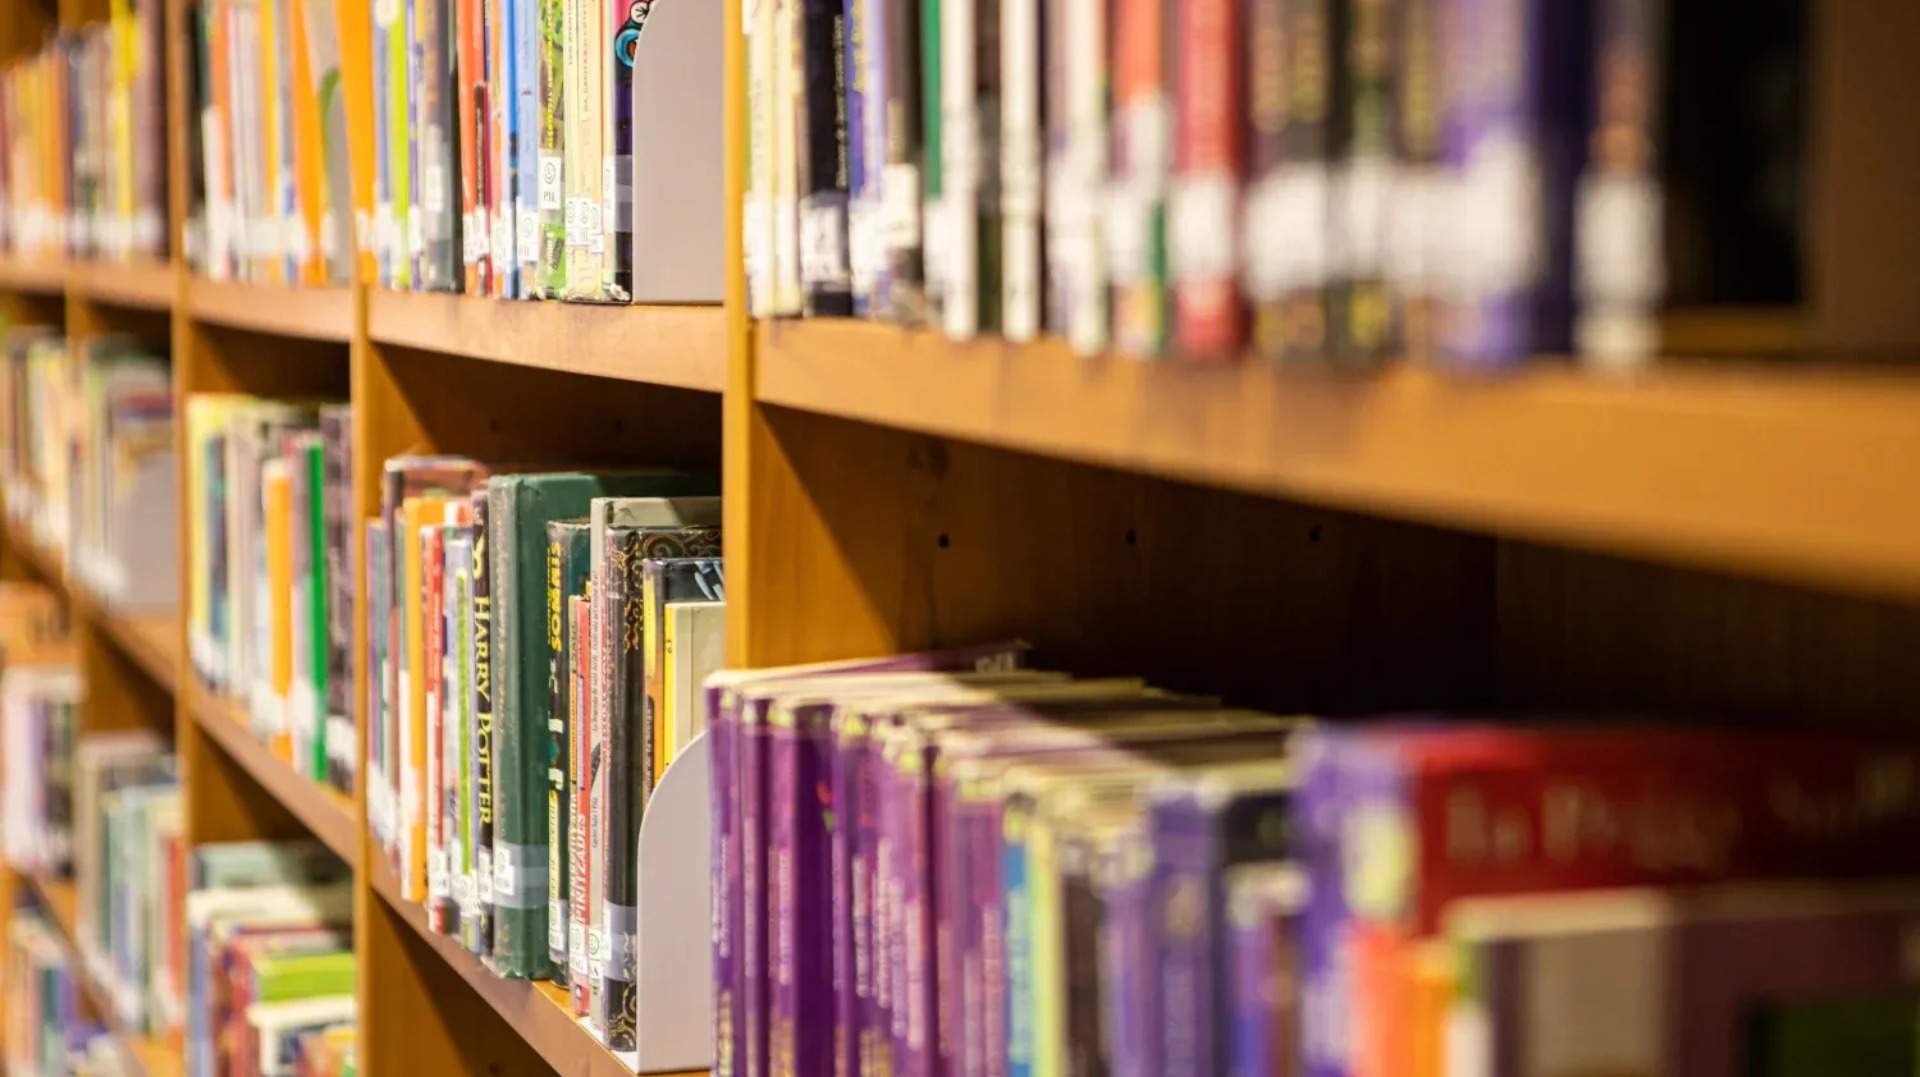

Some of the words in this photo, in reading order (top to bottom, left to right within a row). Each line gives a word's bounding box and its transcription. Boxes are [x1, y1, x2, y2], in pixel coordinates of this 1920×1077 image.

[474, 595, 491, 702] HARRY
[550, 543, 561, 652] SOMNIS
[477, 711, 492, 825] POTTER
